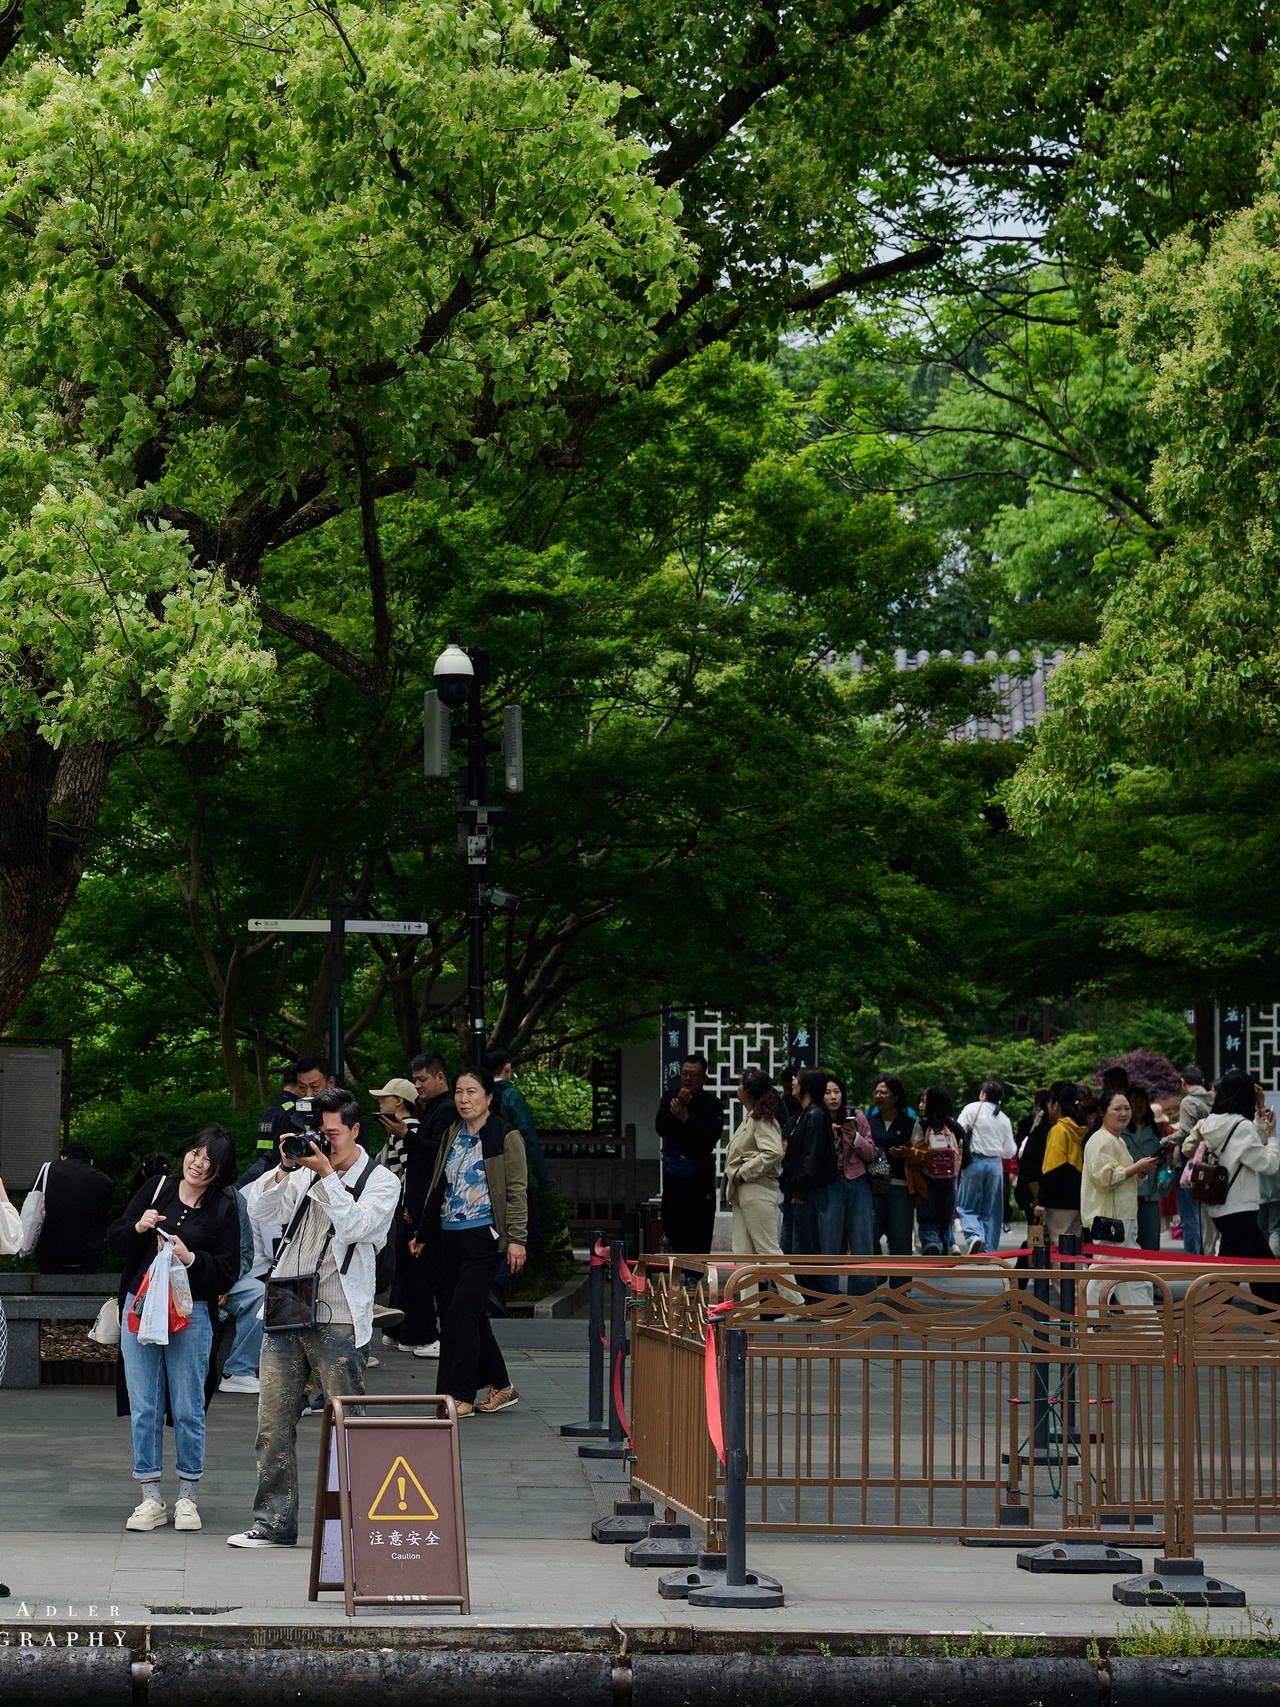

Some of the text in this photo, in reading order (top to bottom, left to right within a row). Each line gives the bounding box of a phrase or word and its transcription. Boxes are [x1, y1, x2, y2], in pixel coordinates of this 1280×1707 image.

[369, 1529, 441, 1547] 注意安全
[391, 1552, 421, 1560] Caution
